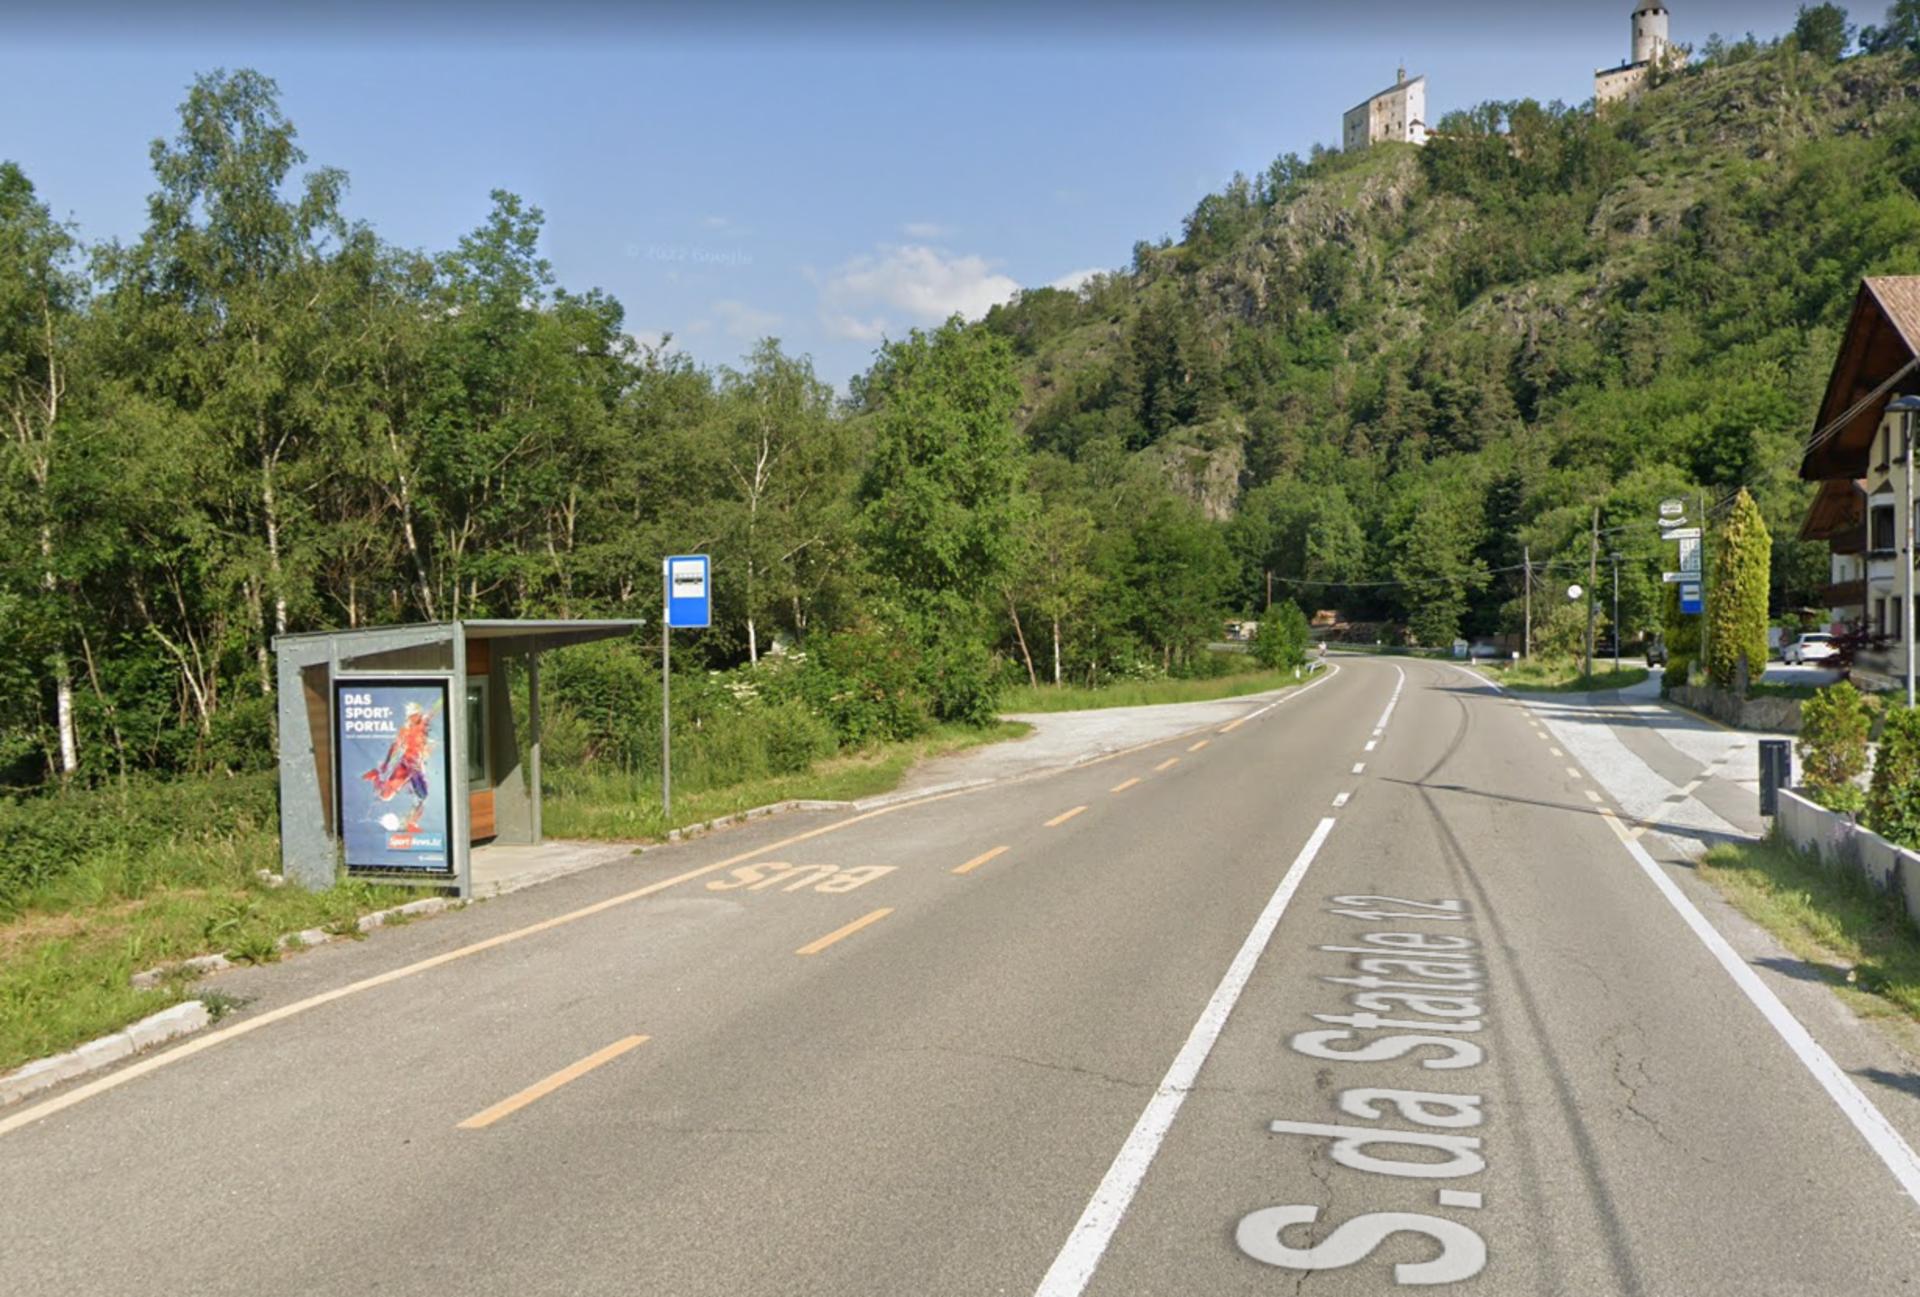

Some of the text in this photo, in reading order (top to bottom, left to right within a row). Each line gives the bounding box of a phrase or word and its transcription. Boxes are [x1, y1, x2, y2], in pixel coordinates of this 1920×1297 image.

[345, 694, 371, 705] DAS
[345, 707, 393, 718] SPORT-
[345, 720, 397, 732] PORTAL
[705, 862, 899, 892] BUS
